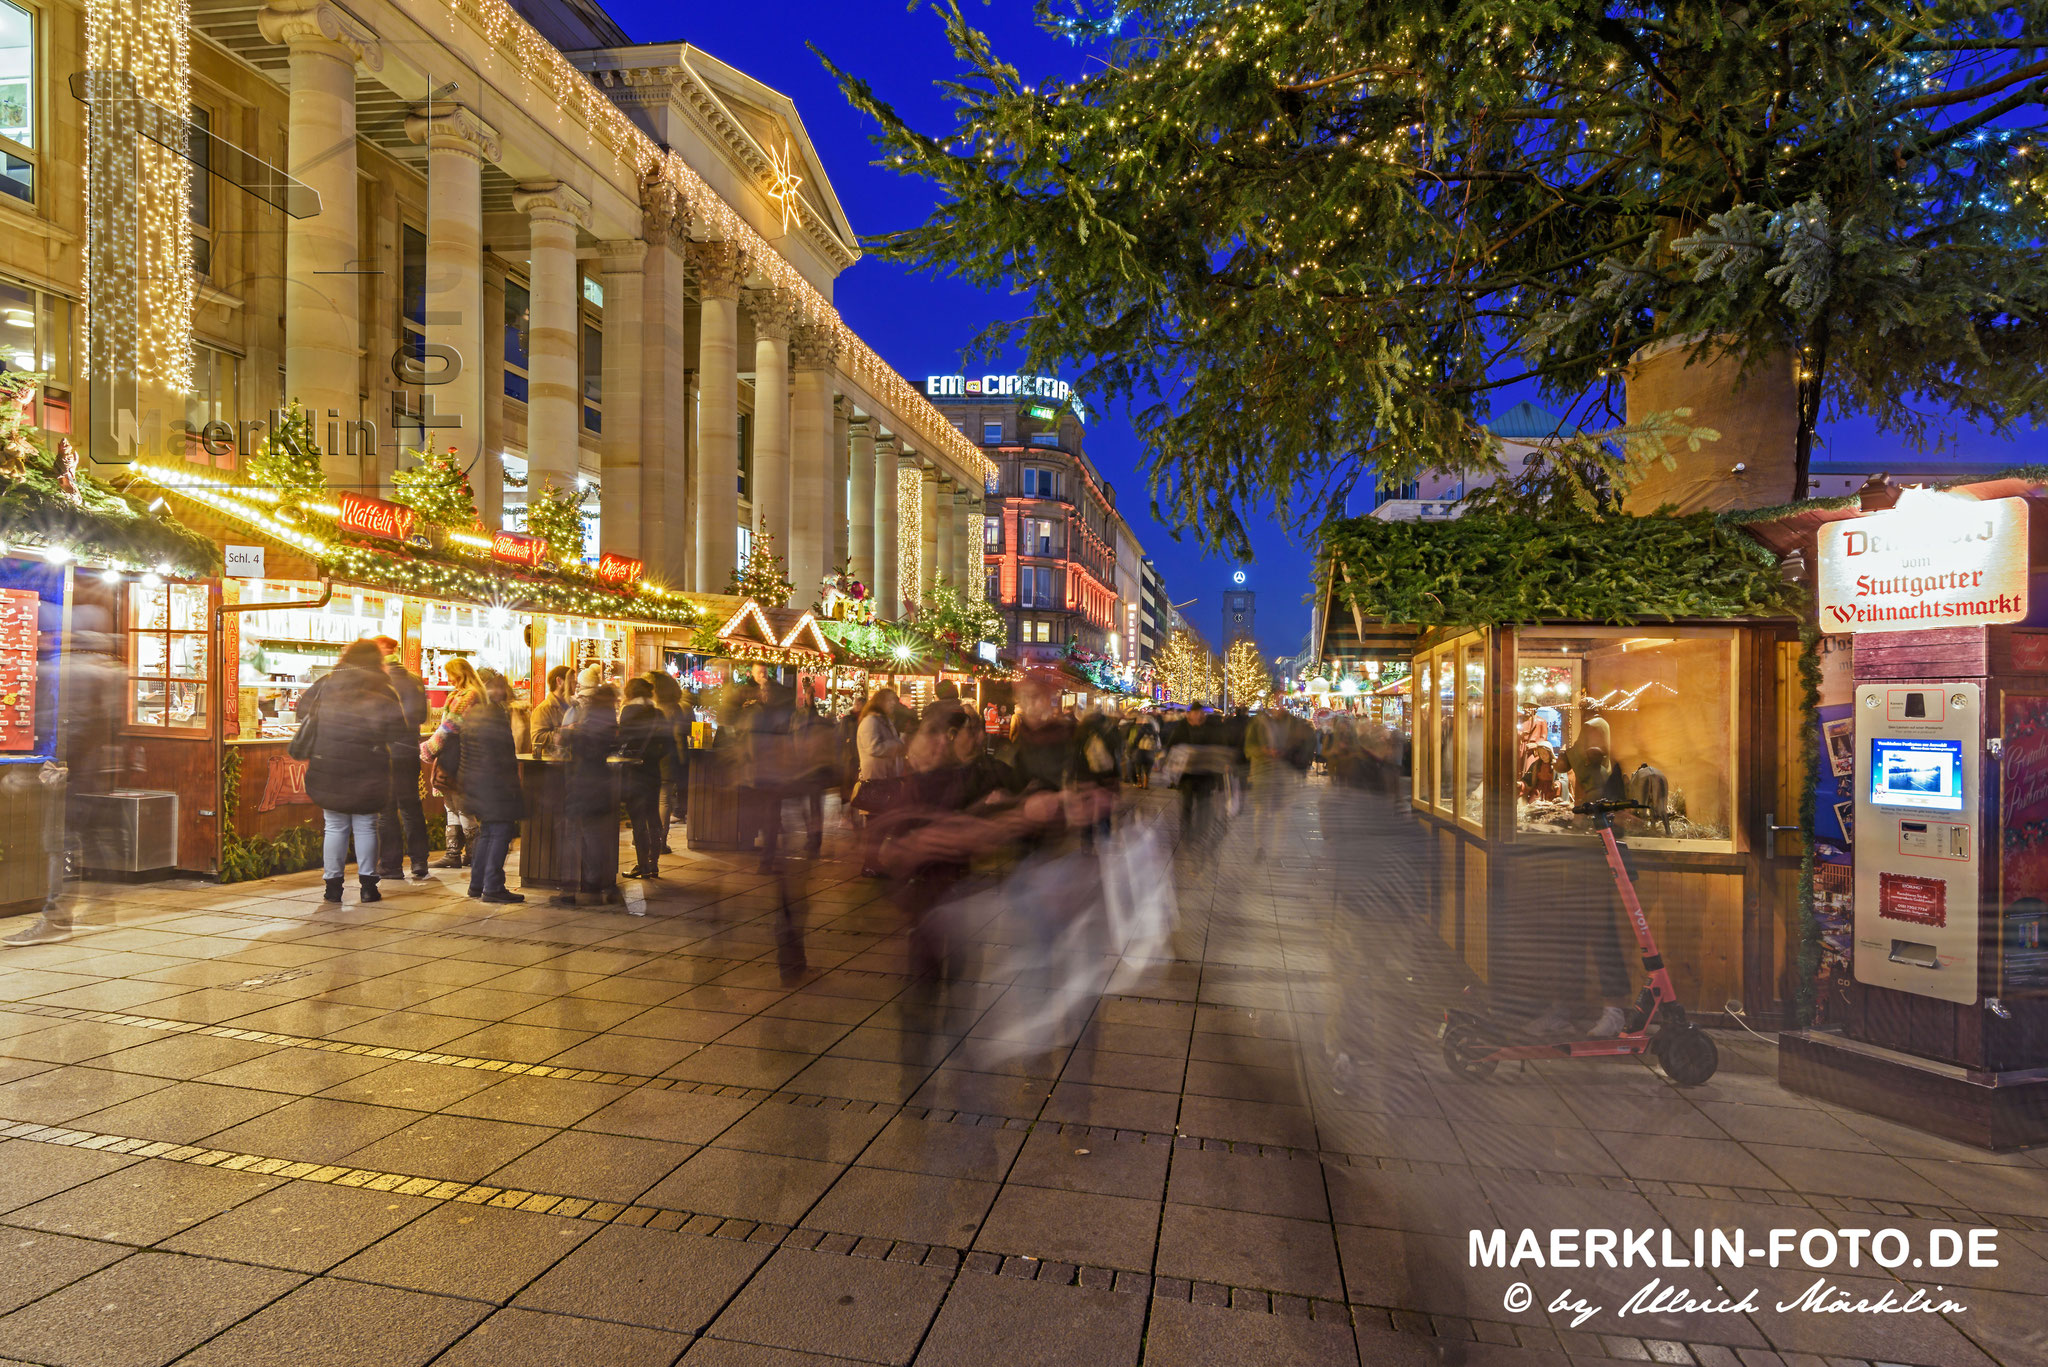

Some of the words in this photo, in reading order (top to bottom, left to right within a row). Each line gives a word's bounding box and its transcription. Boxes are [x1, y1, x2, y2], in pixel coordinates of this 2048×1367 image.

[927, 375, 965, 395] EM
[982, 375, 1069, 401] CINEMA
[229, 552, 250, 563] Schl.
[253, 554, 260, 563] 4
[1901, 557, 1931, 569] vom
[1855, 568, 1984, 598] Stuttgarter
[1824, 593, 2022, 625] Weihnachtsmarkt
